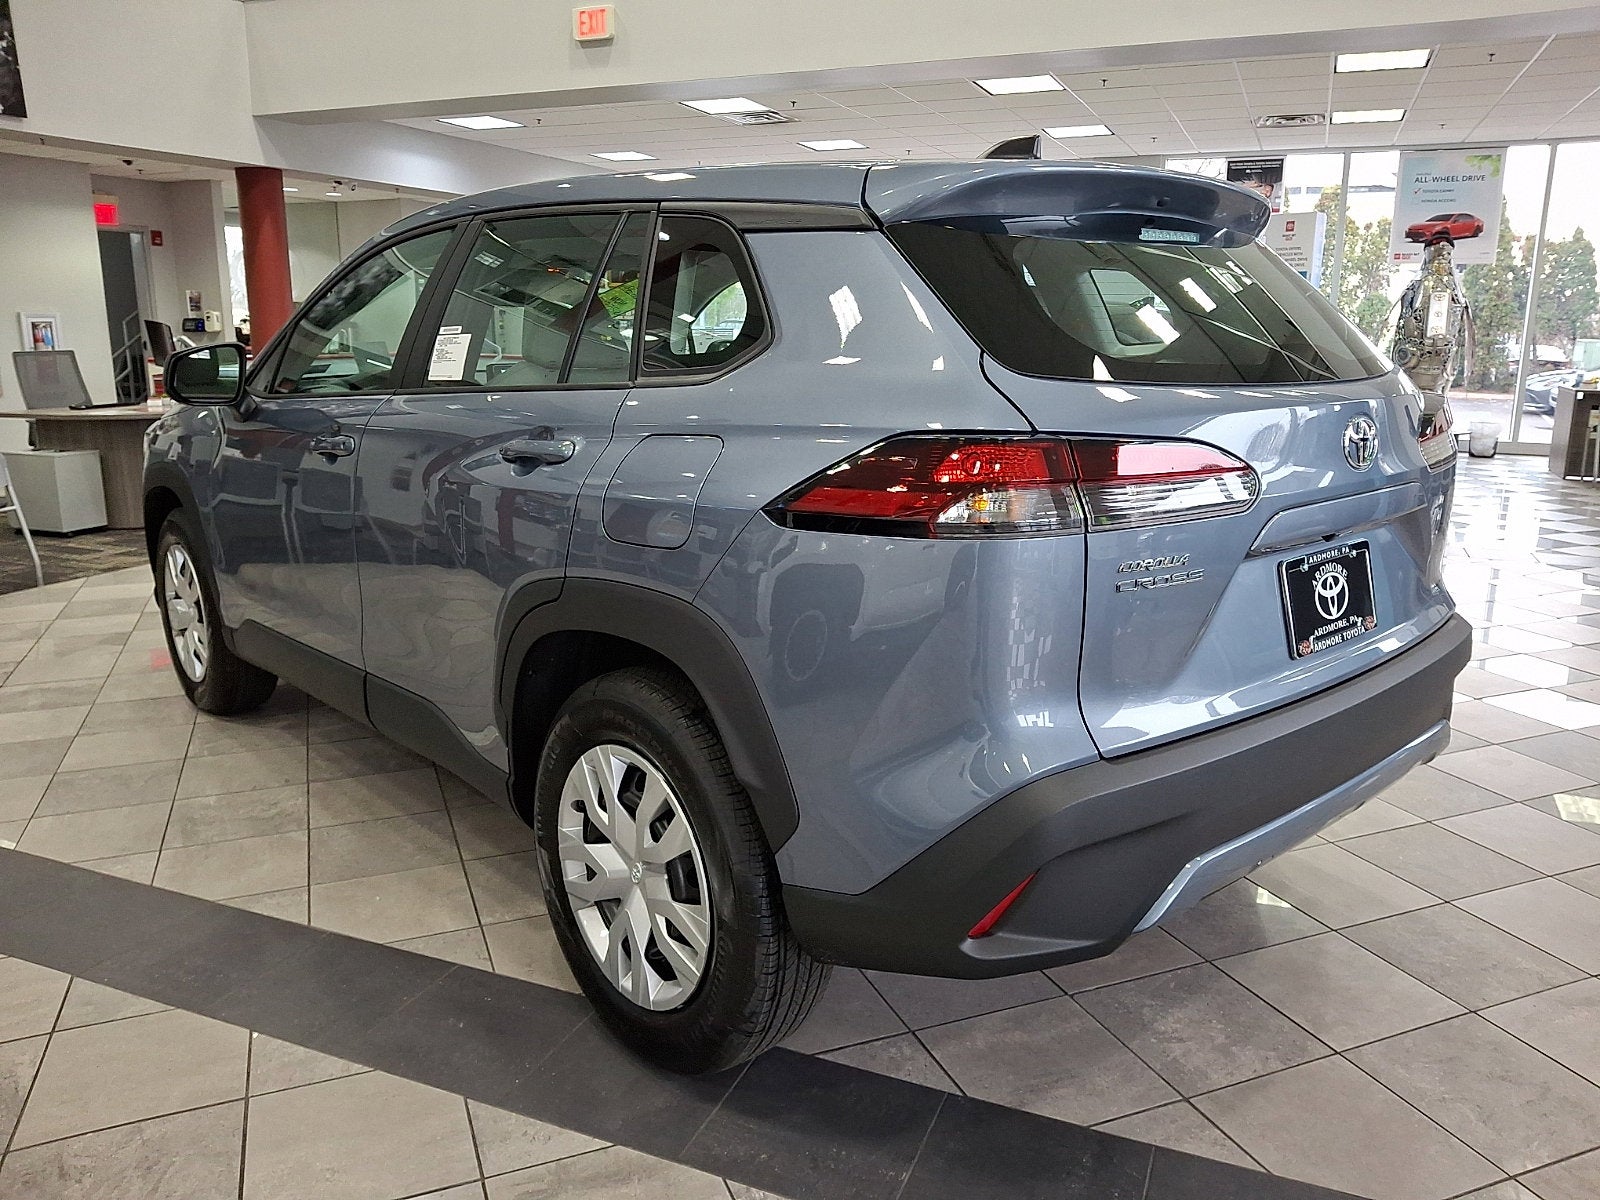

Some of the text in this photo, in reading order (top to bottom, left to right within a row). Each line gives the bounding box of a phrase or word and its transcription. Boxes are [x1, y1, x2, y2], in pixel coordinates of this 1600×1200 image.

[579, 9, 606, 36] EXIT
[1414, 174, 1486, 184] ALL-WHEEL DRIVE
[1118, 553, 1190, 573] COROLLA
[1309, 546, 1350, 564] ARDMORE, PA
[1116, 568, 1205, 593] CROSS
[1312, 562, 1349, 591] ARDMORE
[1313, 618, 1350, 638] ARDMORE,
[1314, 625, 1366, 653] ARDMORE TOYOTA
